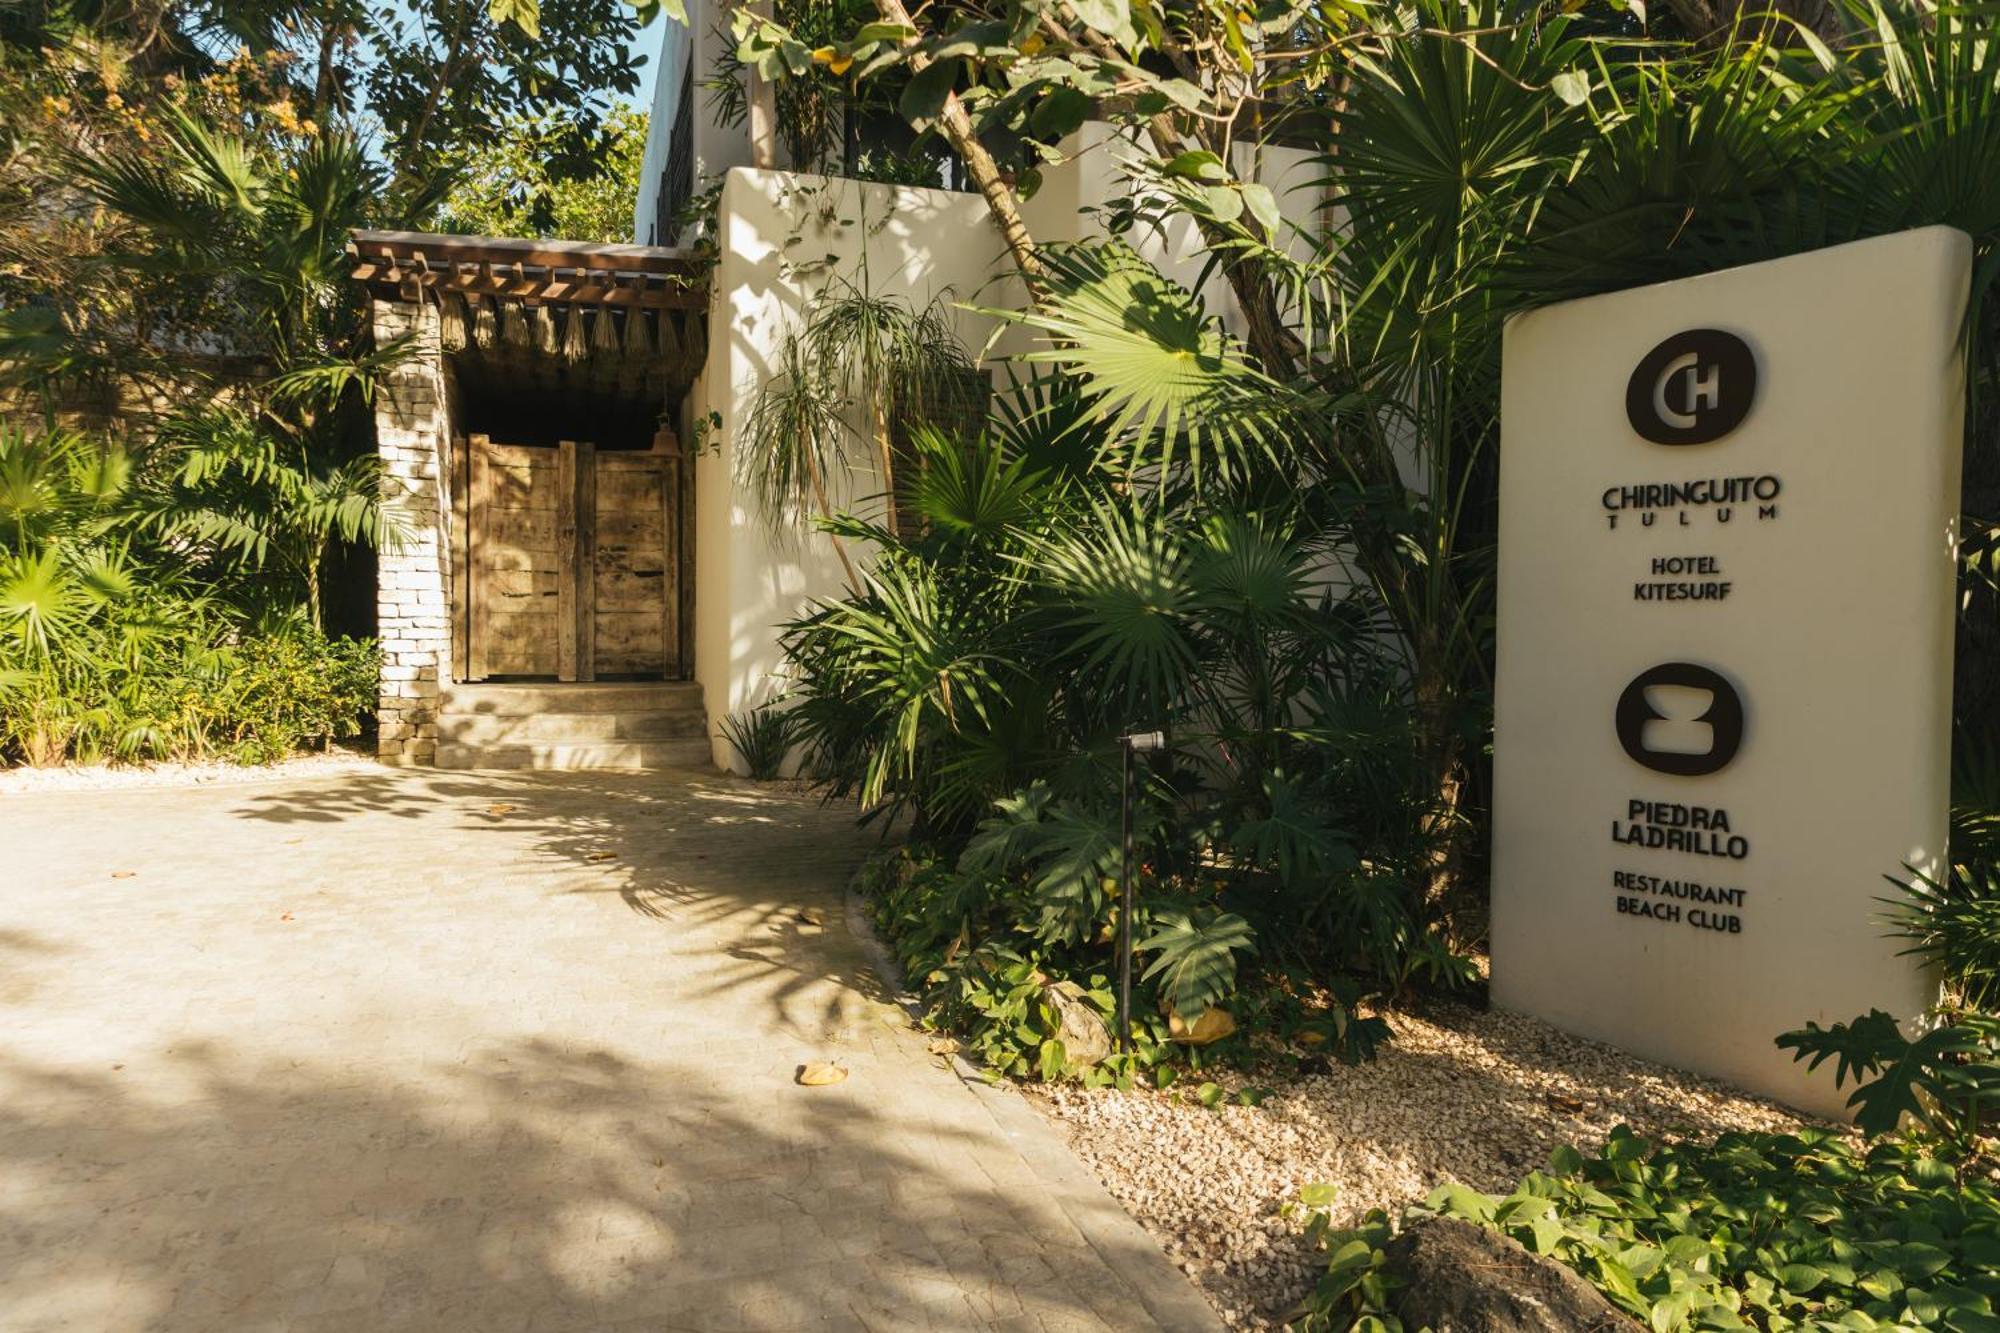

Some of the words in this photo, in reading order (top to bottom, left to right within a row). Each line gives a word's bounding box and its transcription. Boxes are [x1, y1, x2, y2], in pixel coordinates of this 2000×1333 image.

[1602, 476, 1781, 510] CHIRINGUITO
[1652, 556, 1720, 575] HOTEL
[1634, 582, 1732, 601] KITESURF
[1628, 799, 1730, 833] PIEDRA
[1612, 821, 1749, 861] LADRILLO
[1613, 870, 1747, 907] RESTAURANT
[1616, 896, 1680, 923] BEACH
[1687, 909, 1742, 934] CLUB
